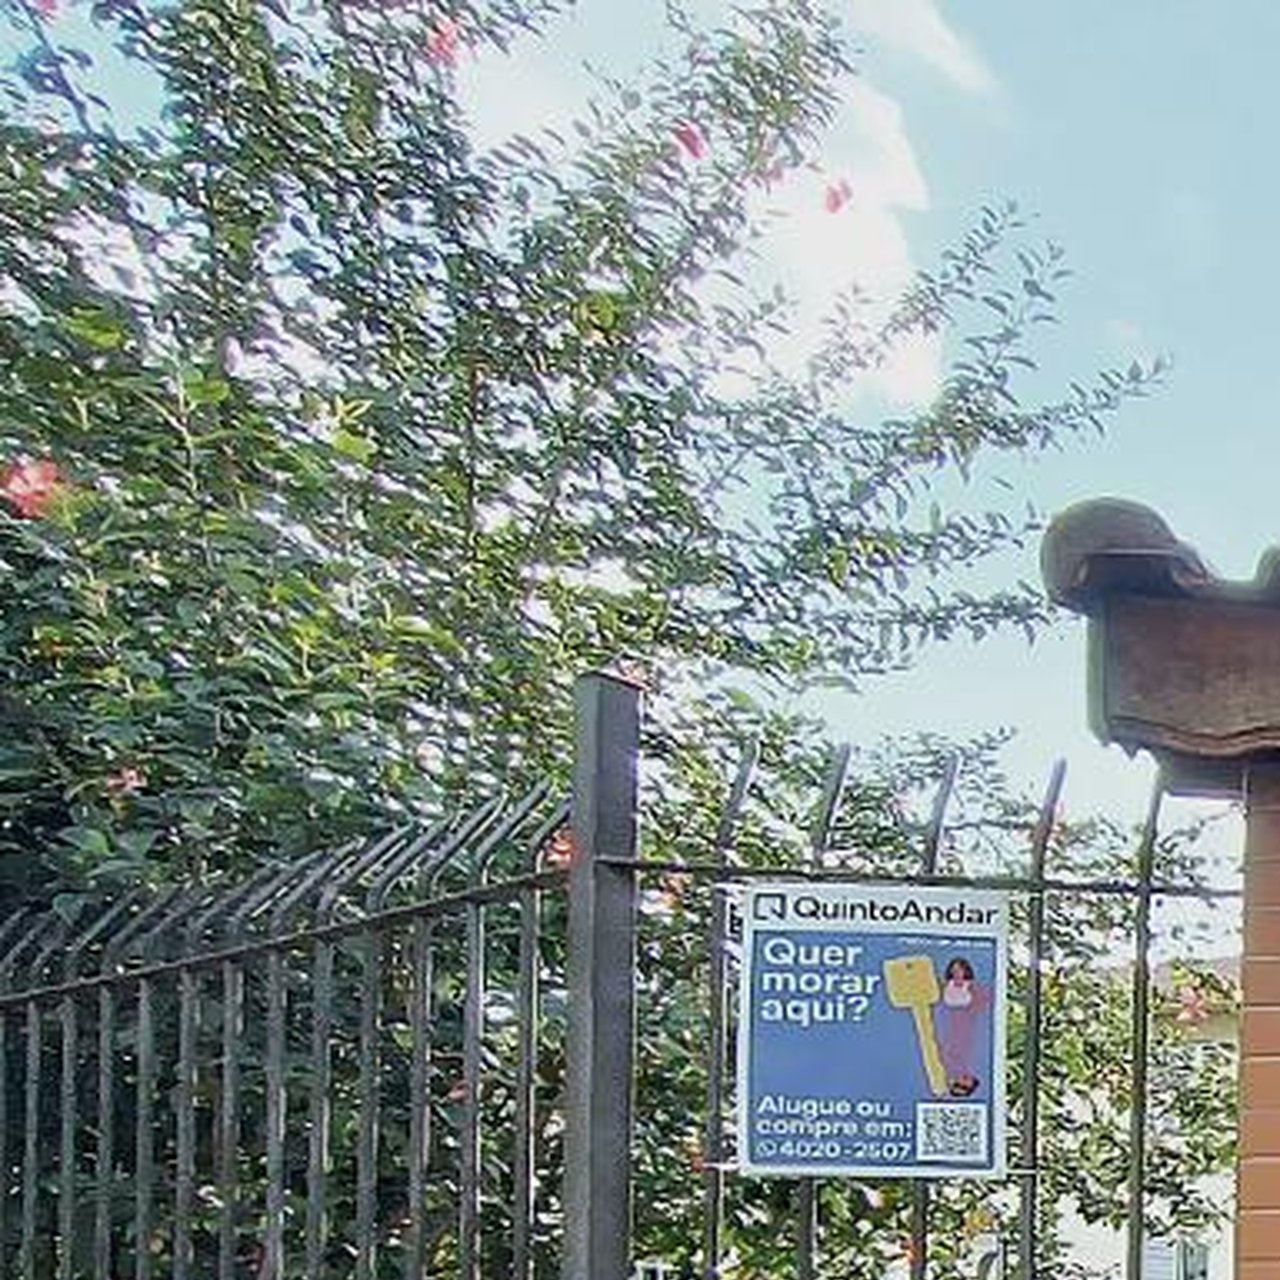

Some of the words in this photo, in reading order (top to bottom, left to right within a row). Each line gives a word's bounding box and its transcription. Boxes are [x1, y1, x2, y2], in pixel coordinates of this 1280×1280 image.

[794, 896, 998, 925] QuintoAndar
[764, 940, 863, 966] Quer
[761, 970, 881, 994] morar
[760, 996, 869, 1026] aqui?
[757, 1096, 851, 1120] Alugue
[857, 1101, 890, 1116] ou
[865, 1121, 912, 1138] em:
